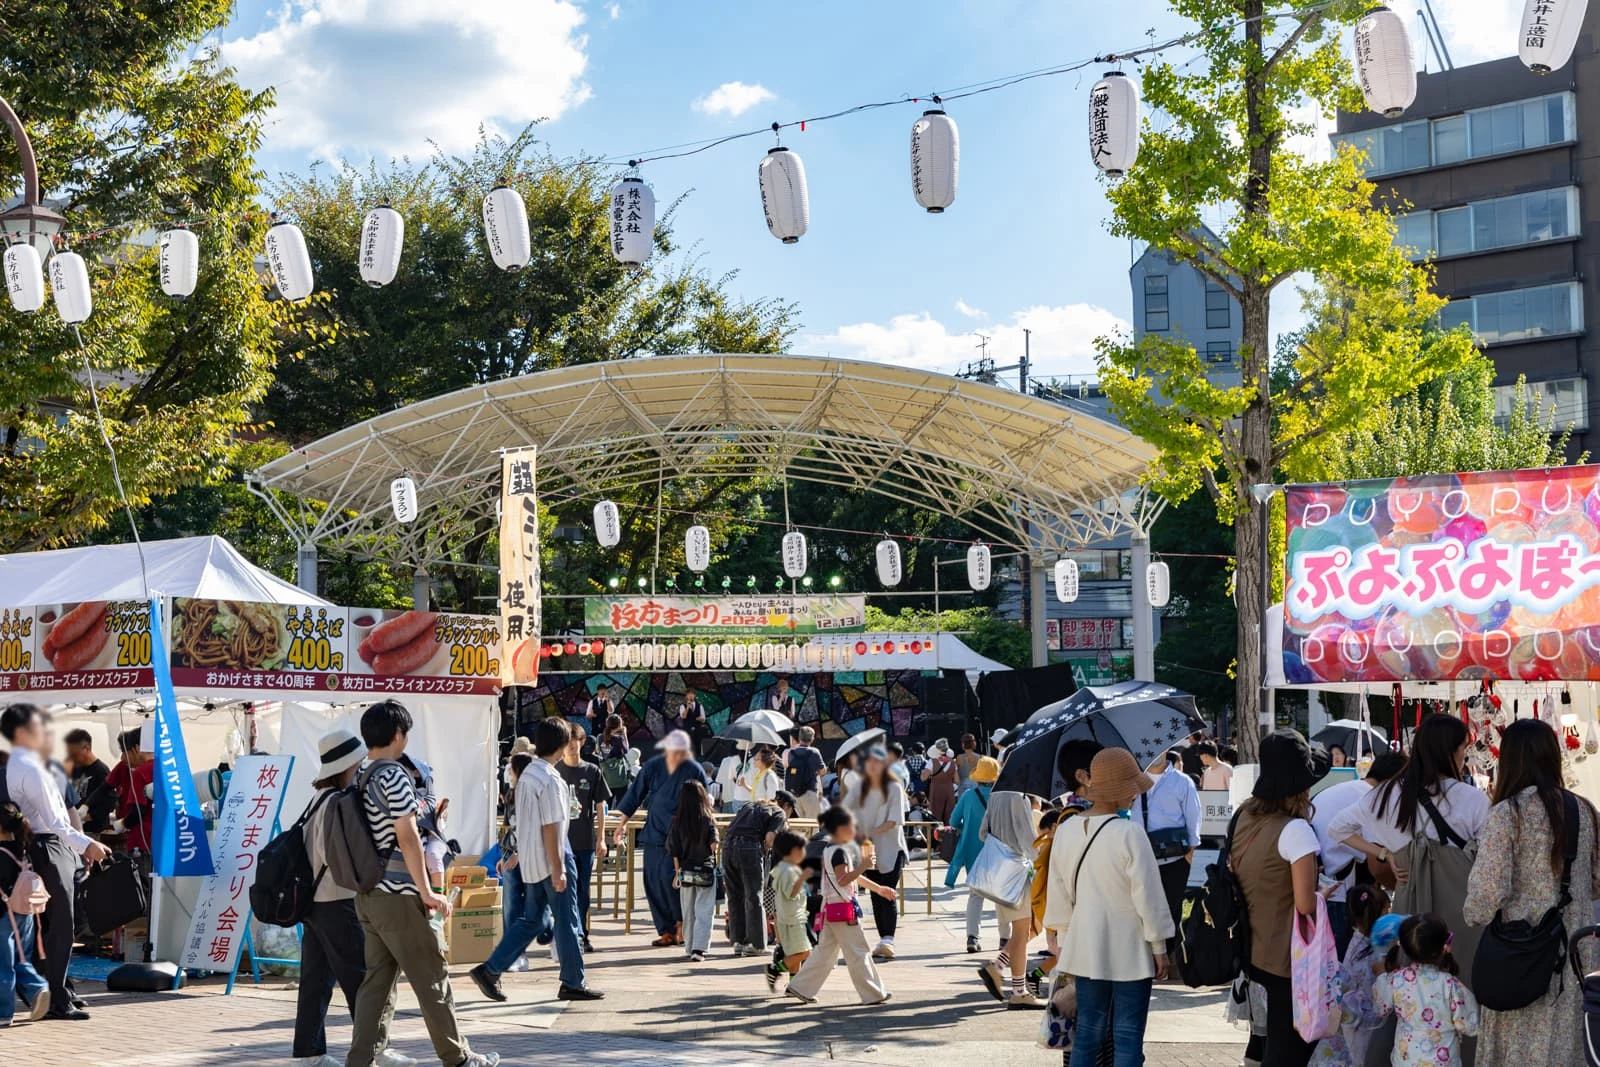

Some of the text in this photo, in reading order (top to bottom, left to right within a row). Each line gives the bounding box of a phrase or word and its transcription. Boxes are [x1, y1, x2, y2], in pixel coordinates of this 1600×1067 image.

[1526, 0, 1555, 48] 井上造園
[1093, 85, 1111, 158] 一般社団法人
[625, 187, 642, 234] 株式会社
[503, 579, 526, 642] 使用
[611, 600, 719, 630] 枚方まつり
[720, 615, 769, 630] 2024
[286, 617, 345, 638] やきそば
[434, 626, 501, 646] フランクフルト
[288, 637, 344, 671] 400円
[450, 644, 500, 677] 200円
[30, 671, 140, 689] 枚方ローズライオンズクラブ
[205, 672, 475, 693] おかげさまで40周年 枚方ローズライオンズクラブ
[208, 763, 280, 964] 枚方まつり会場
